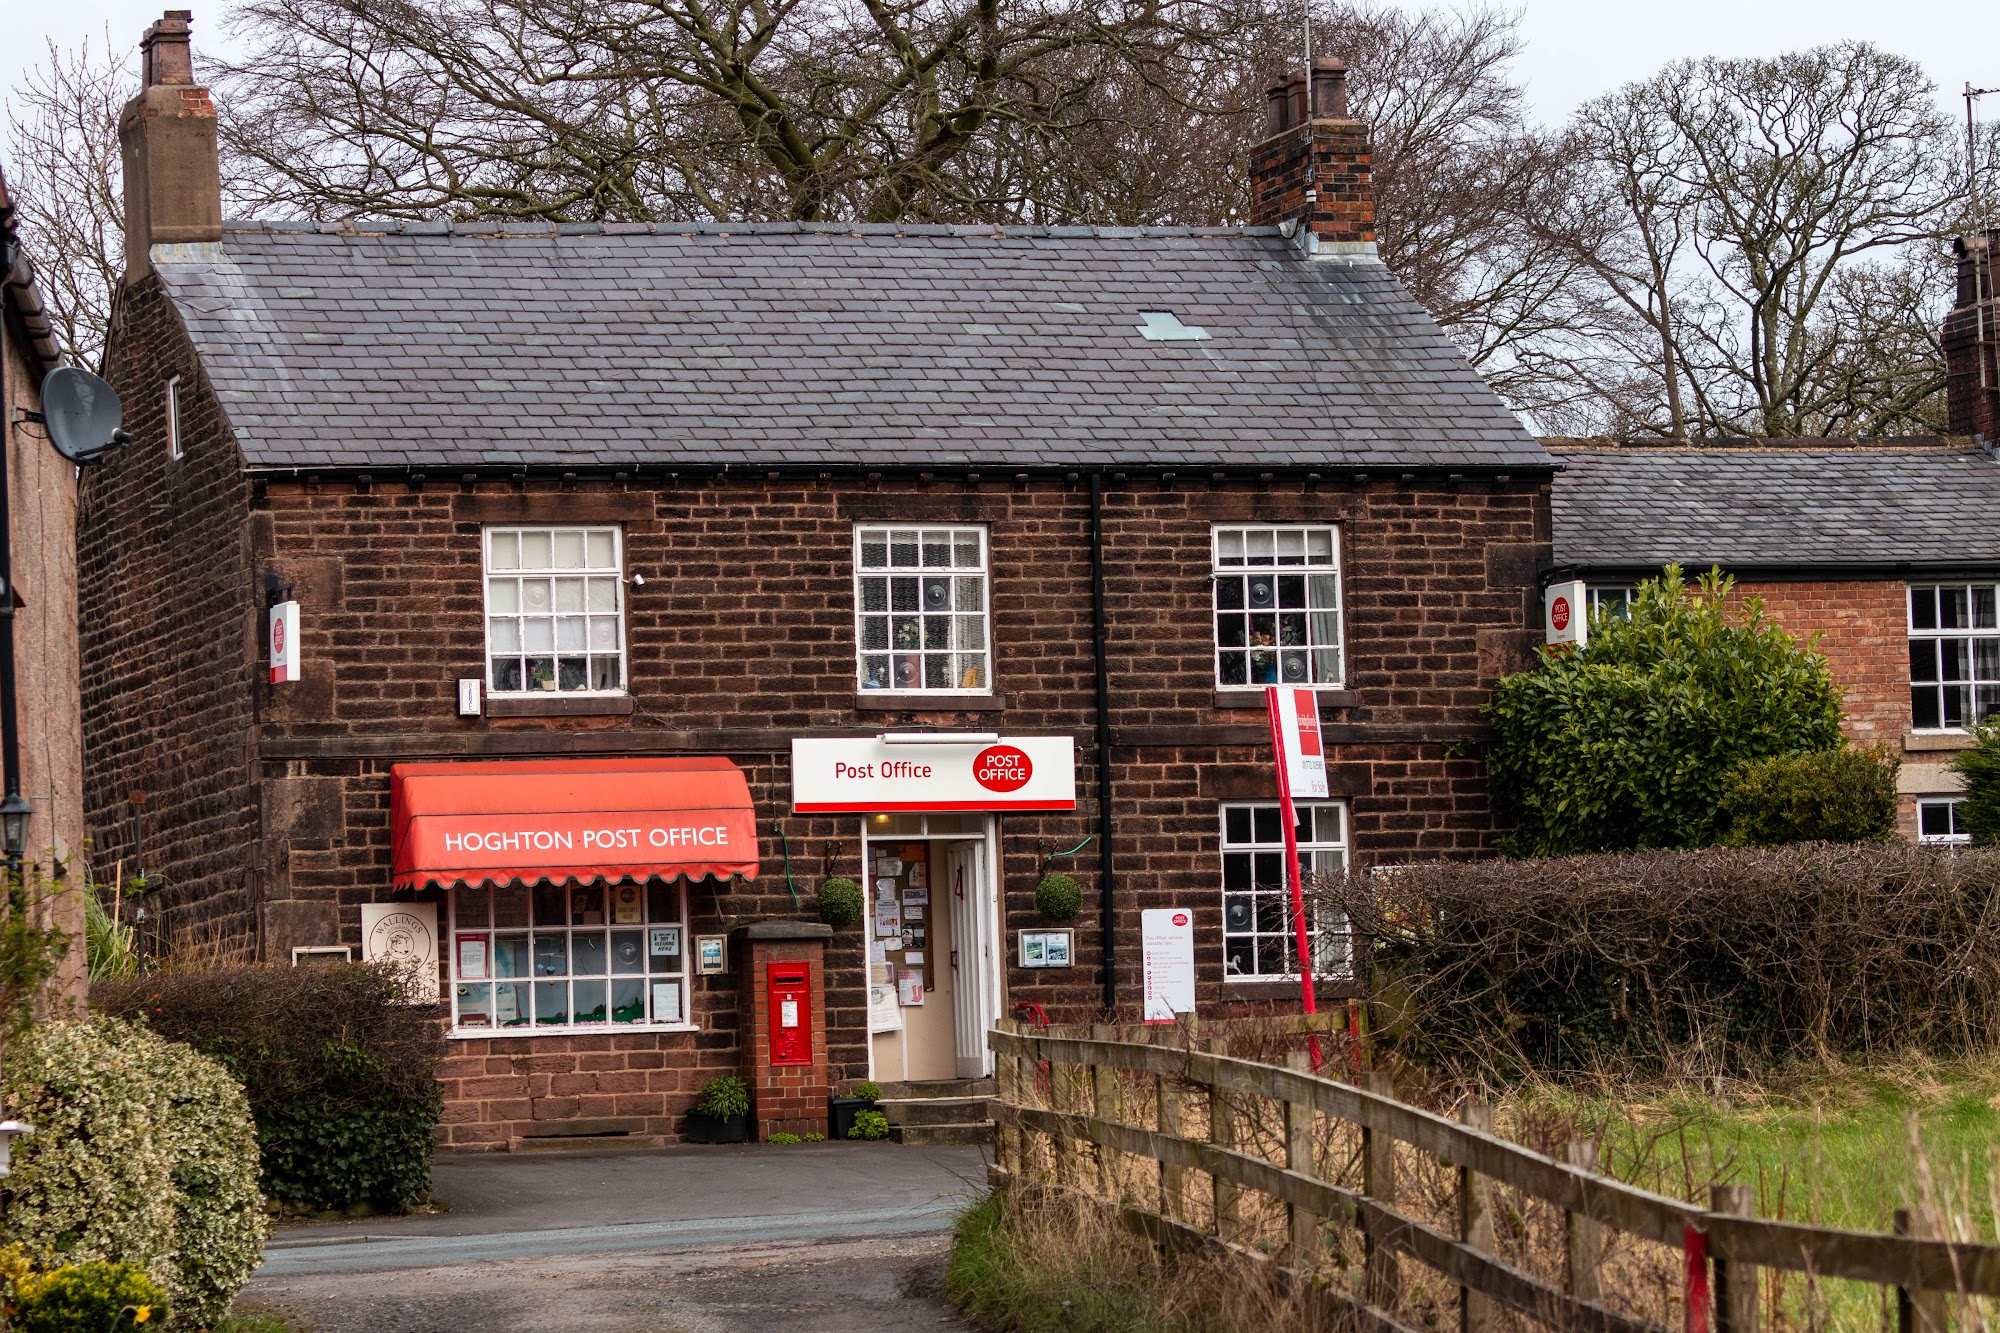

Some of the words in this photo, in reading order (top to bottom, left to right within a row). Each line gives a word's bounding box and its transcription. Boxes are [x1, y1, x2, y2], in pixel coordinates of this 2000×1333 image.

[1554, 604, 1566, 613] POST
[1552, 612, 1568, 623] OFFICE
[986, 754, 1020, 767] POST
[835, 762, 874, 779] Post
[880, 761, 932, 778] Office
[978, 768, 1026, 780] OFFICE
[445, 830, 573, 852] HOGHTON
[583, 829, 642, 849] POST
[648, 826, 729, 848] OFFICE
[376, 916, 423, 934] WALLINGS
